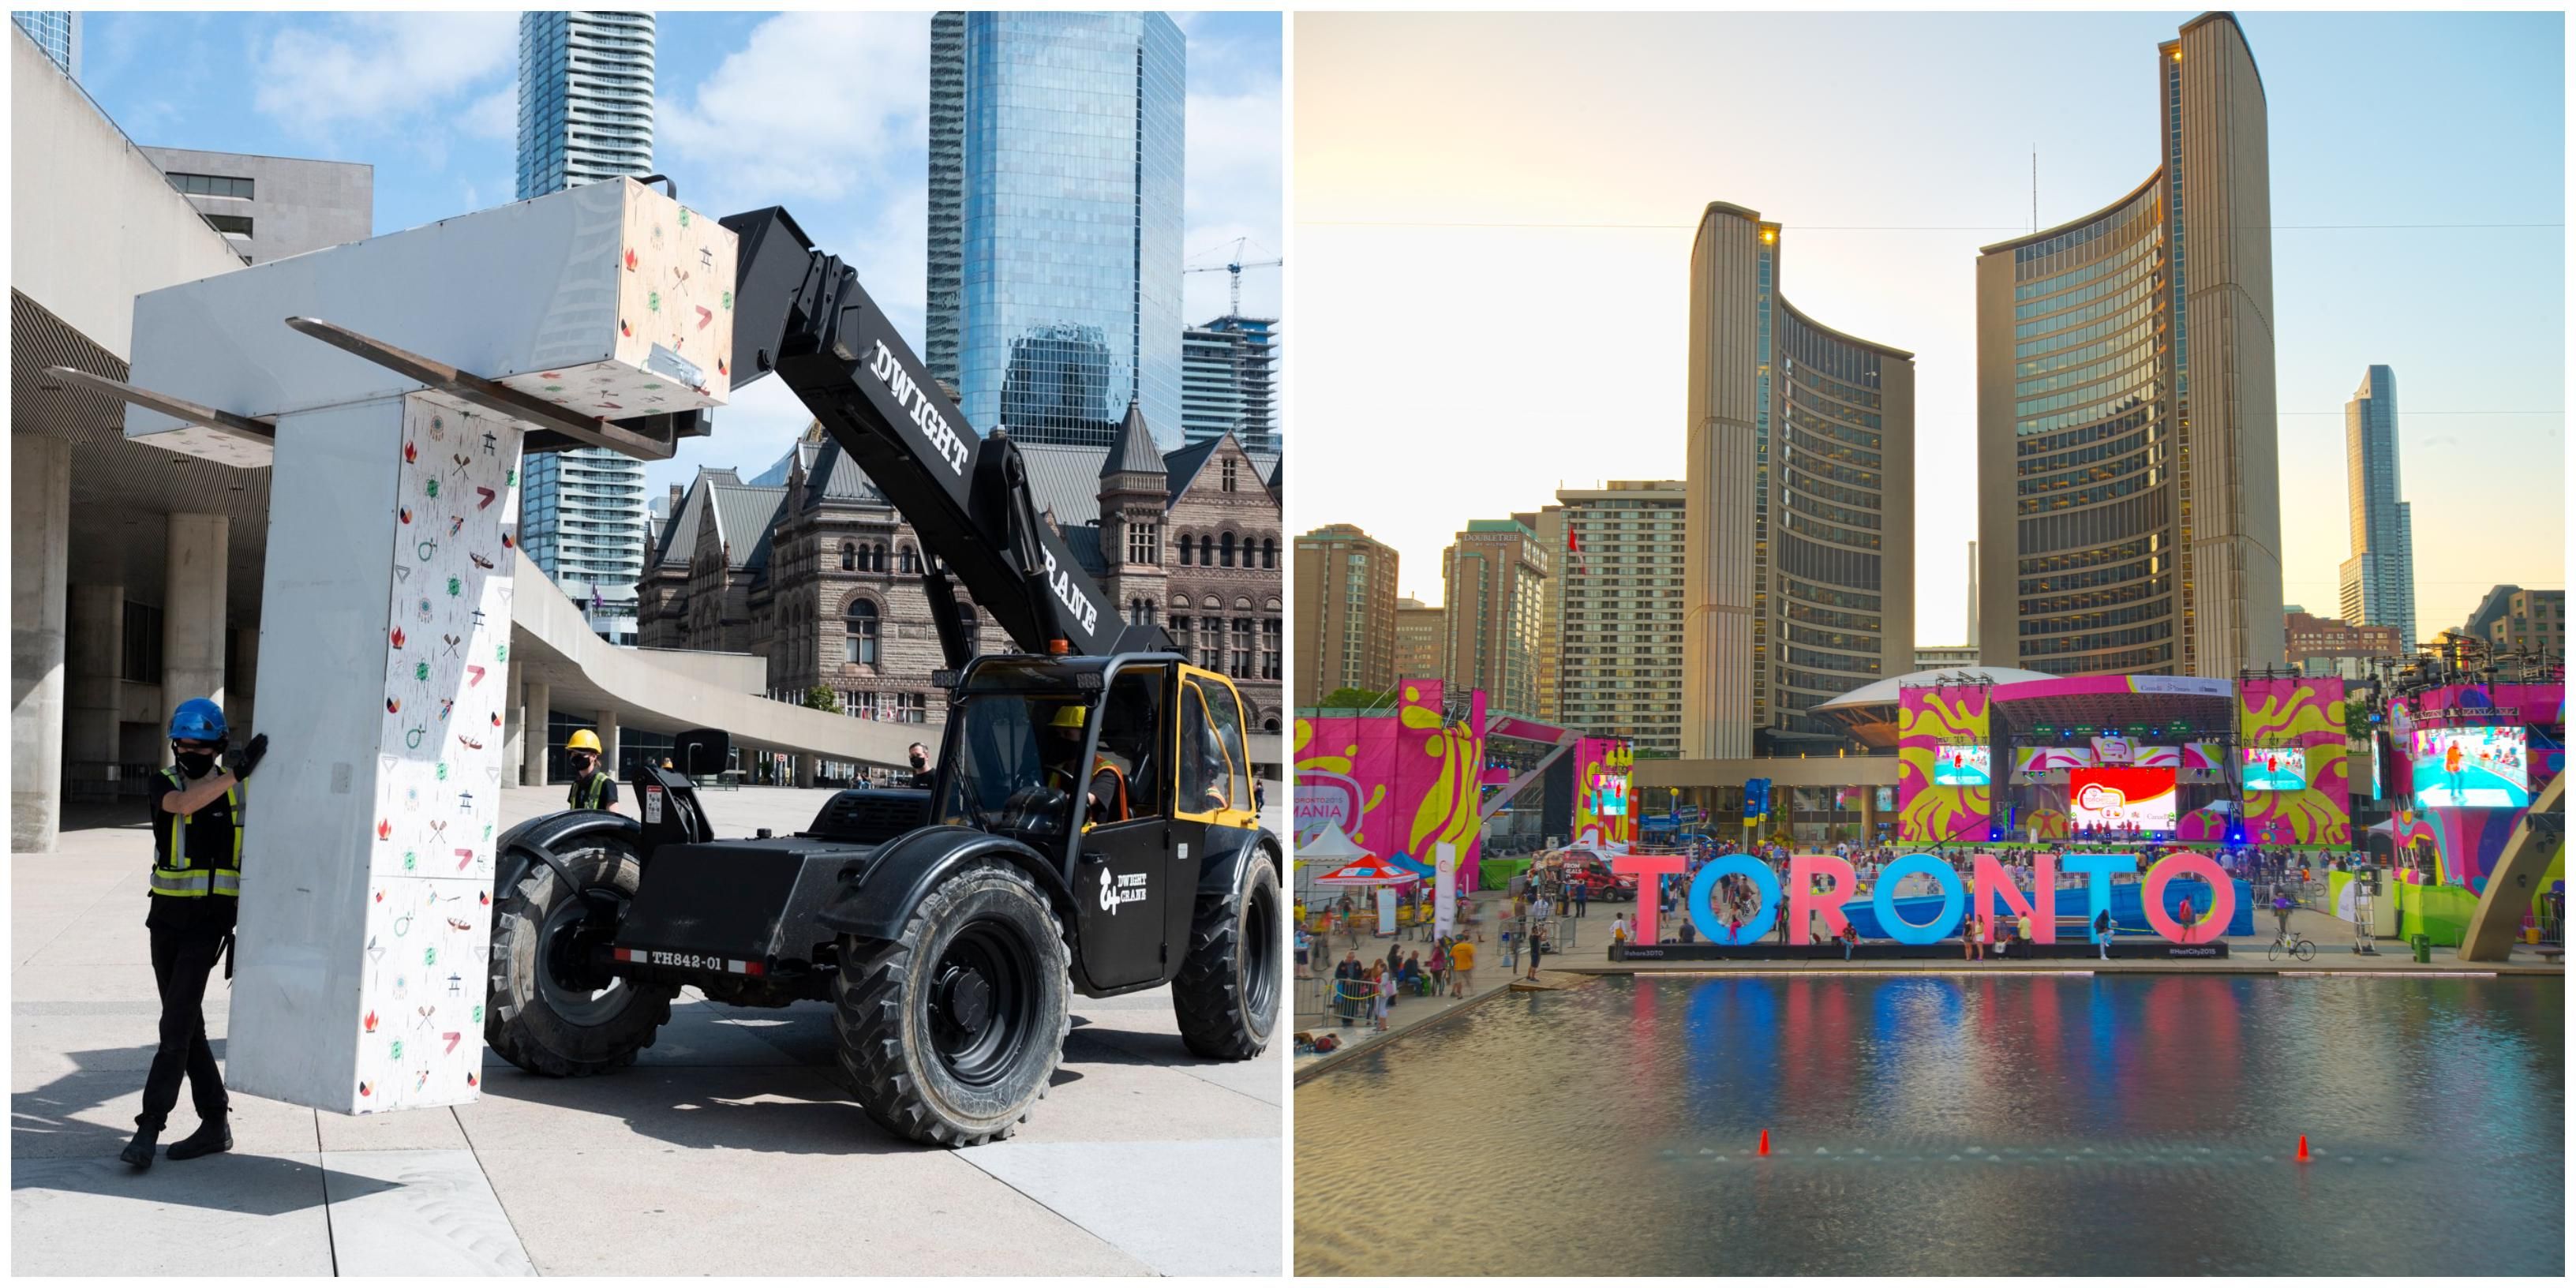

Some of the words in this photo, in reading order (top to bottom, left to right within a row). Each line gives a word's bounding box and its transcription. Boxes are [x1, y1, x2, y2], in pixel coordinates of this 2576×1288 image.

[871, 339, 969, 477] DWIGHT
[1040, 541, 1098, 637] RANE
[1118, 873, 1147, 888] DWIGHT
[1121, 888, 1147, 903] CRANE
[1612, 853, 2236, 945] TORONTO
[652, 951, 721, 971] TH842-01
